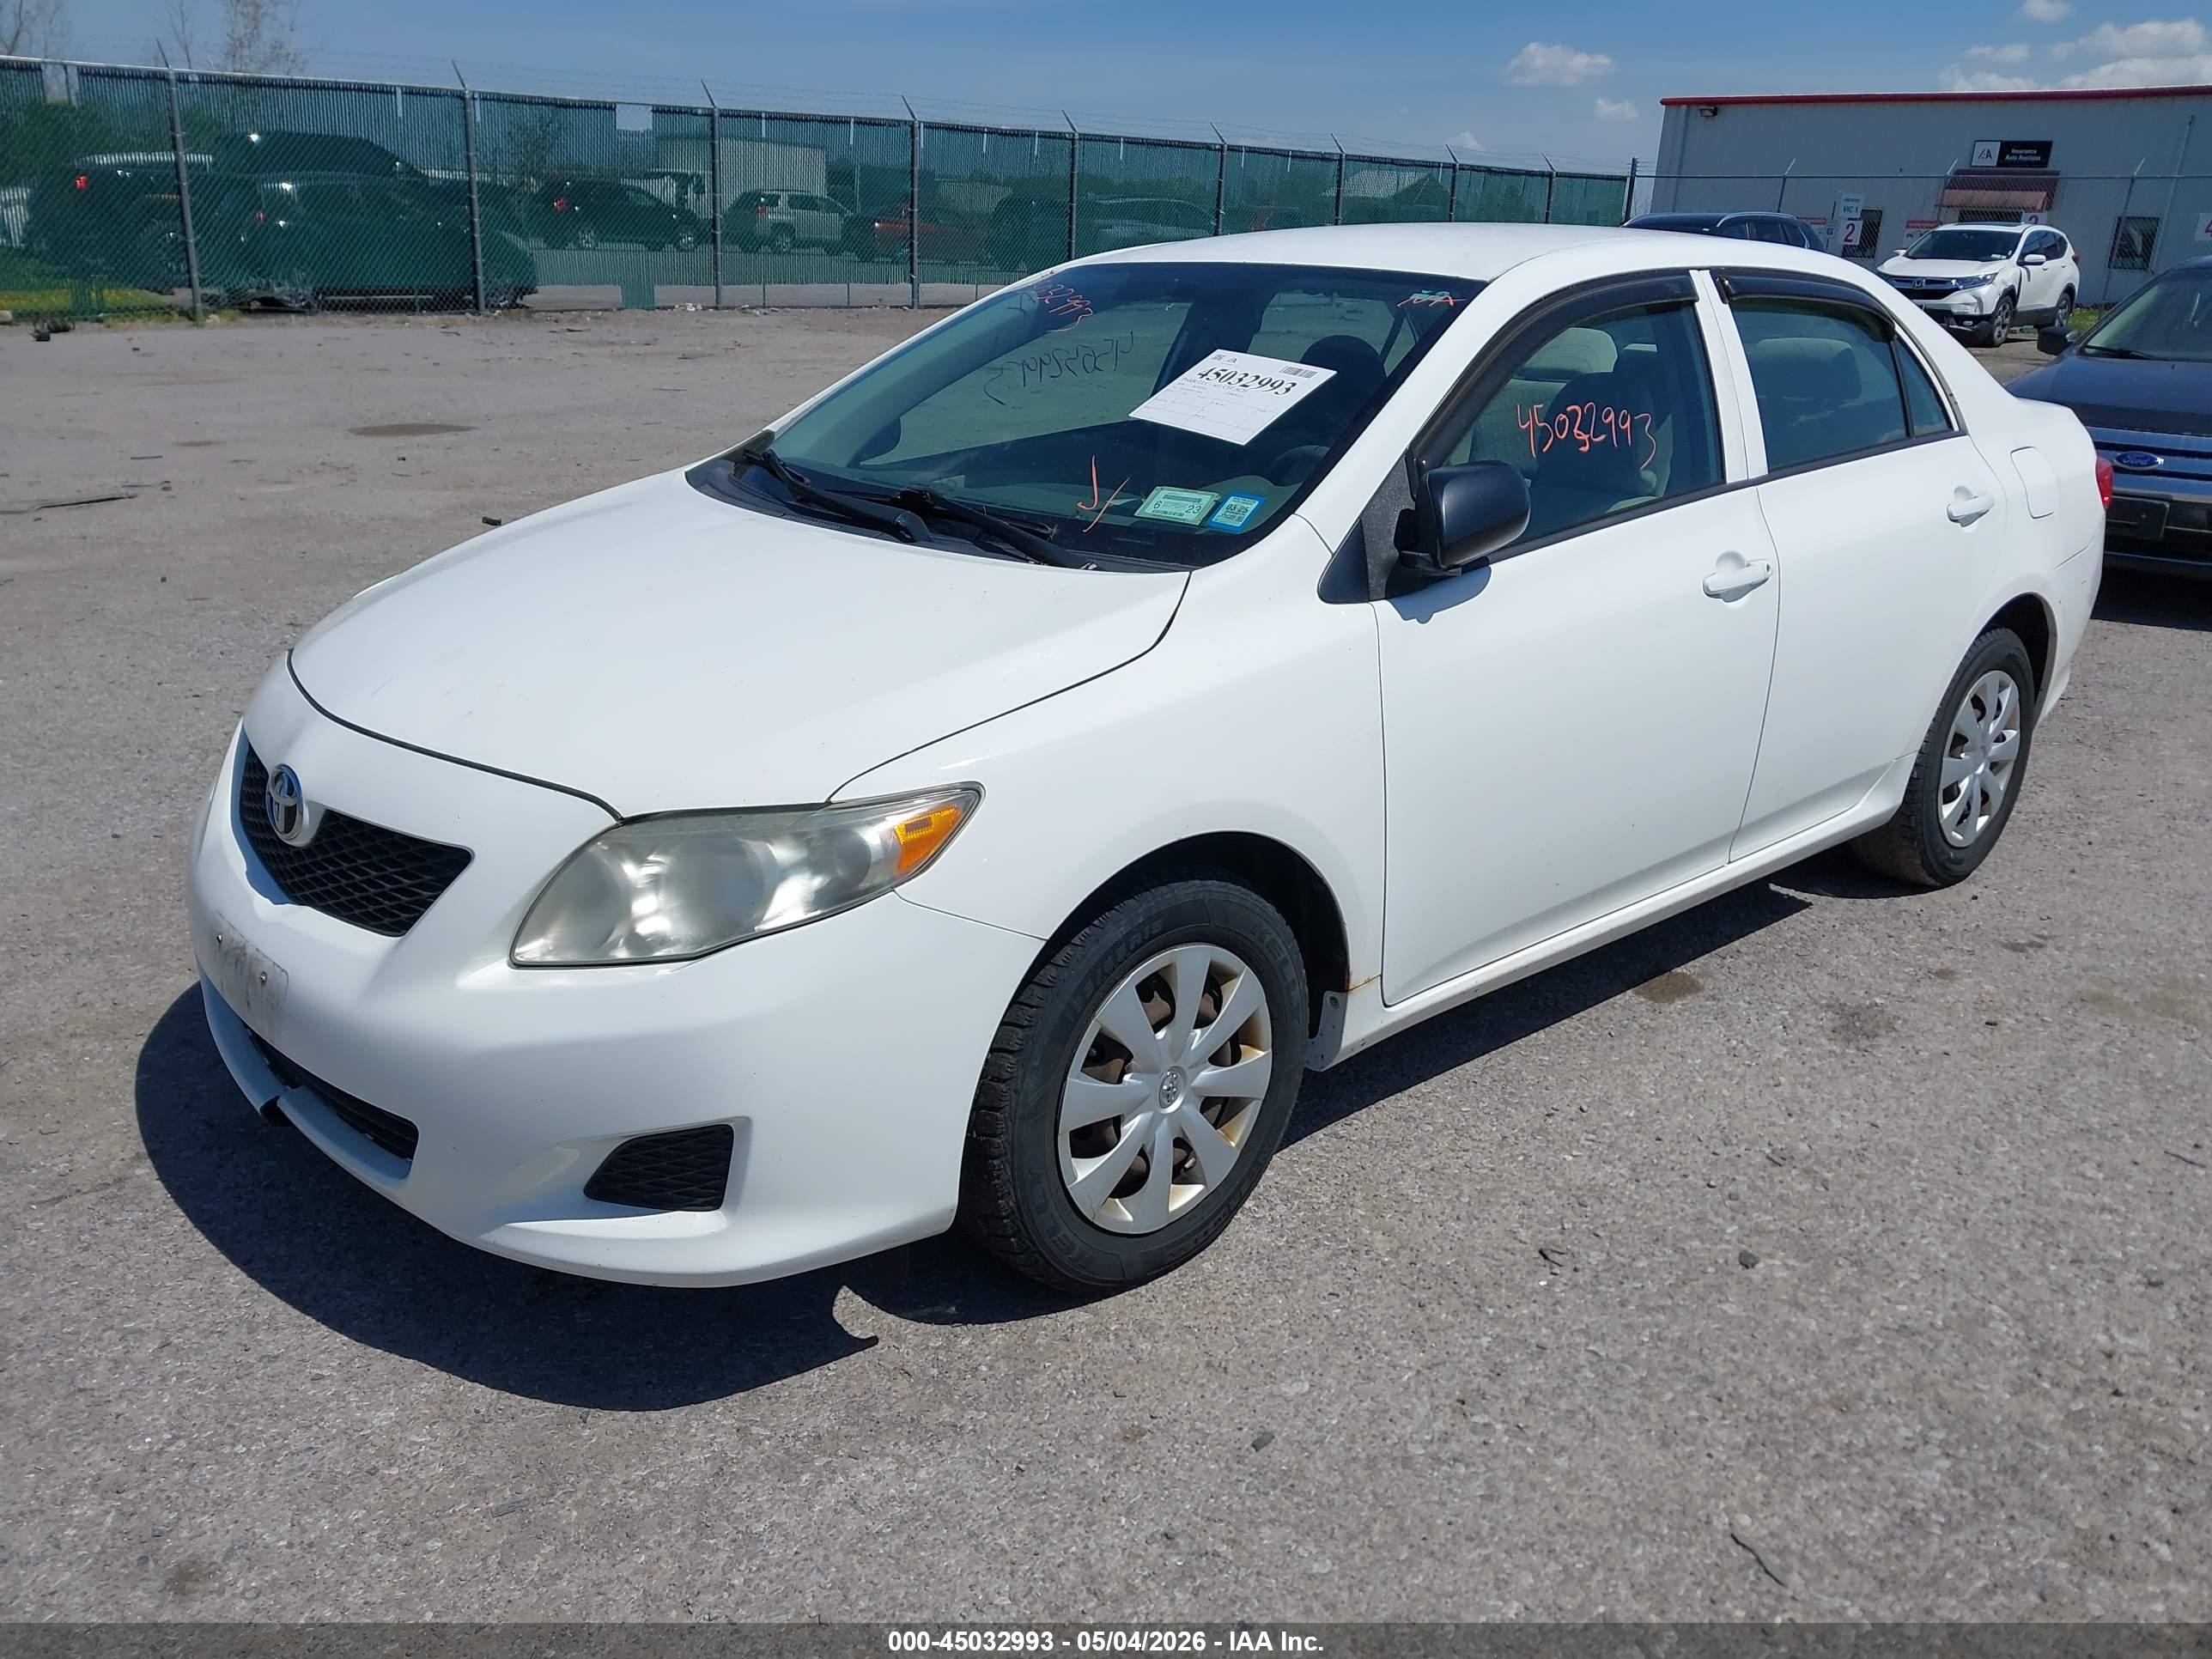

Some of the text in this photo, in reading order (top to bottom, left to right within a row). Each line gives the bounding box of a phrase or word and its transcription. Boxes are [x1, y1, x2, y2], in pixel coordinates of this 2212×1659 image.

[1844, 223, 1856, 243] 2
[1196, 367, 1297, 396] 45032993
[1153, 501, 1163, 509] 6
[1185, 505, 1202, 514] 23
